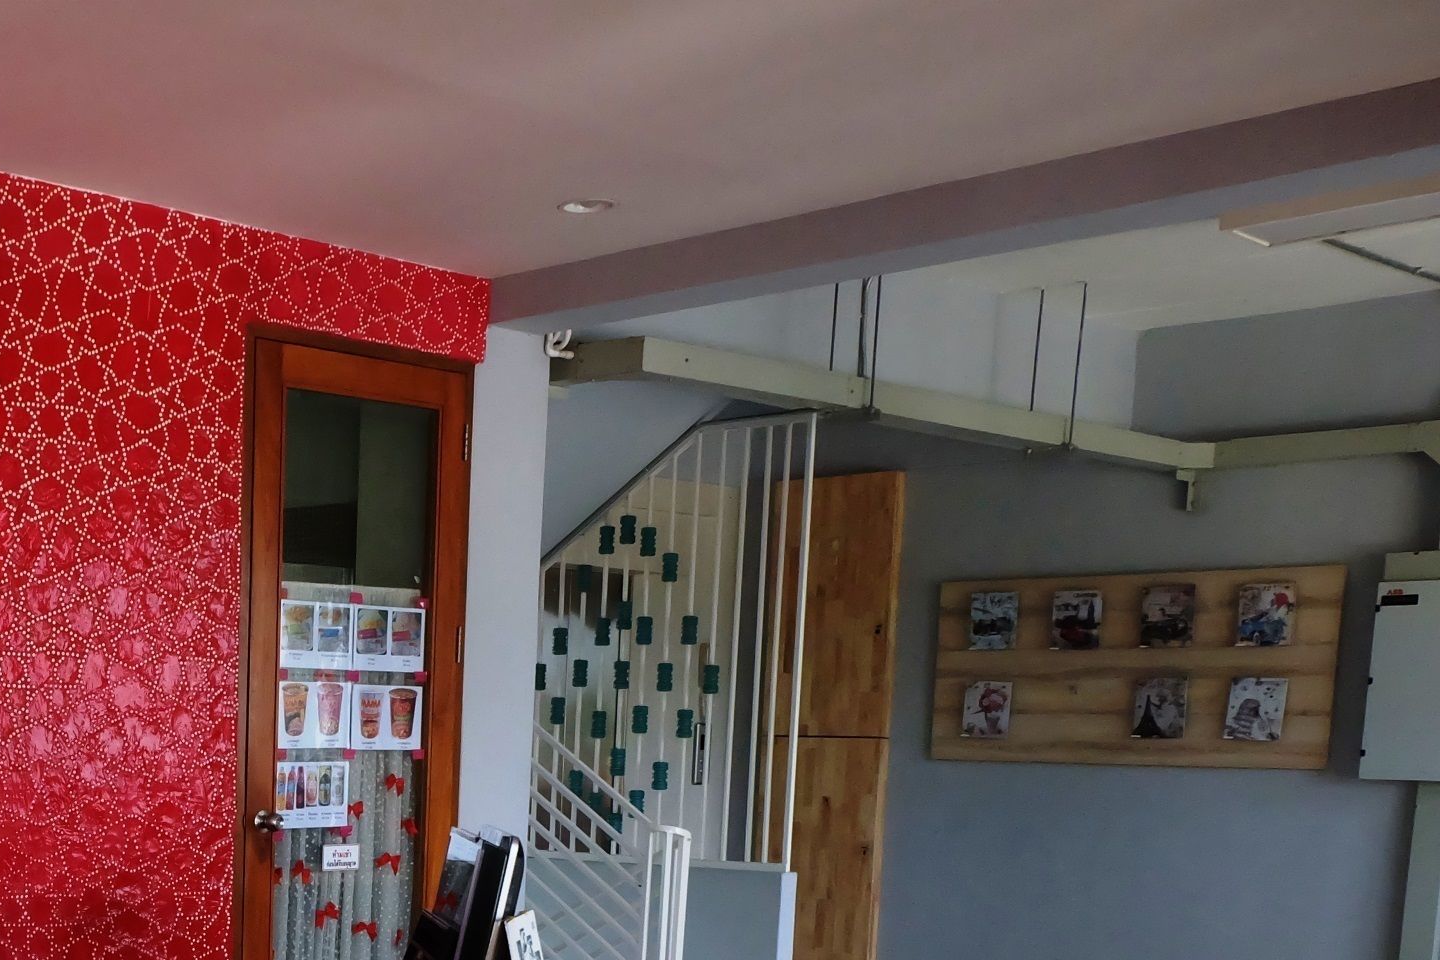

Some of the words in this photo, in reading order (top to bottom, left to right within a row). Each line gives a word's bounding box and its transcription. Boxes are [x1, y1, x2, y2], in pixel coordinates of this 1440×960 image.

[1386, 588, 1404, 596] ABB
[332, 849, 352, 858] ห้ามเข้า
